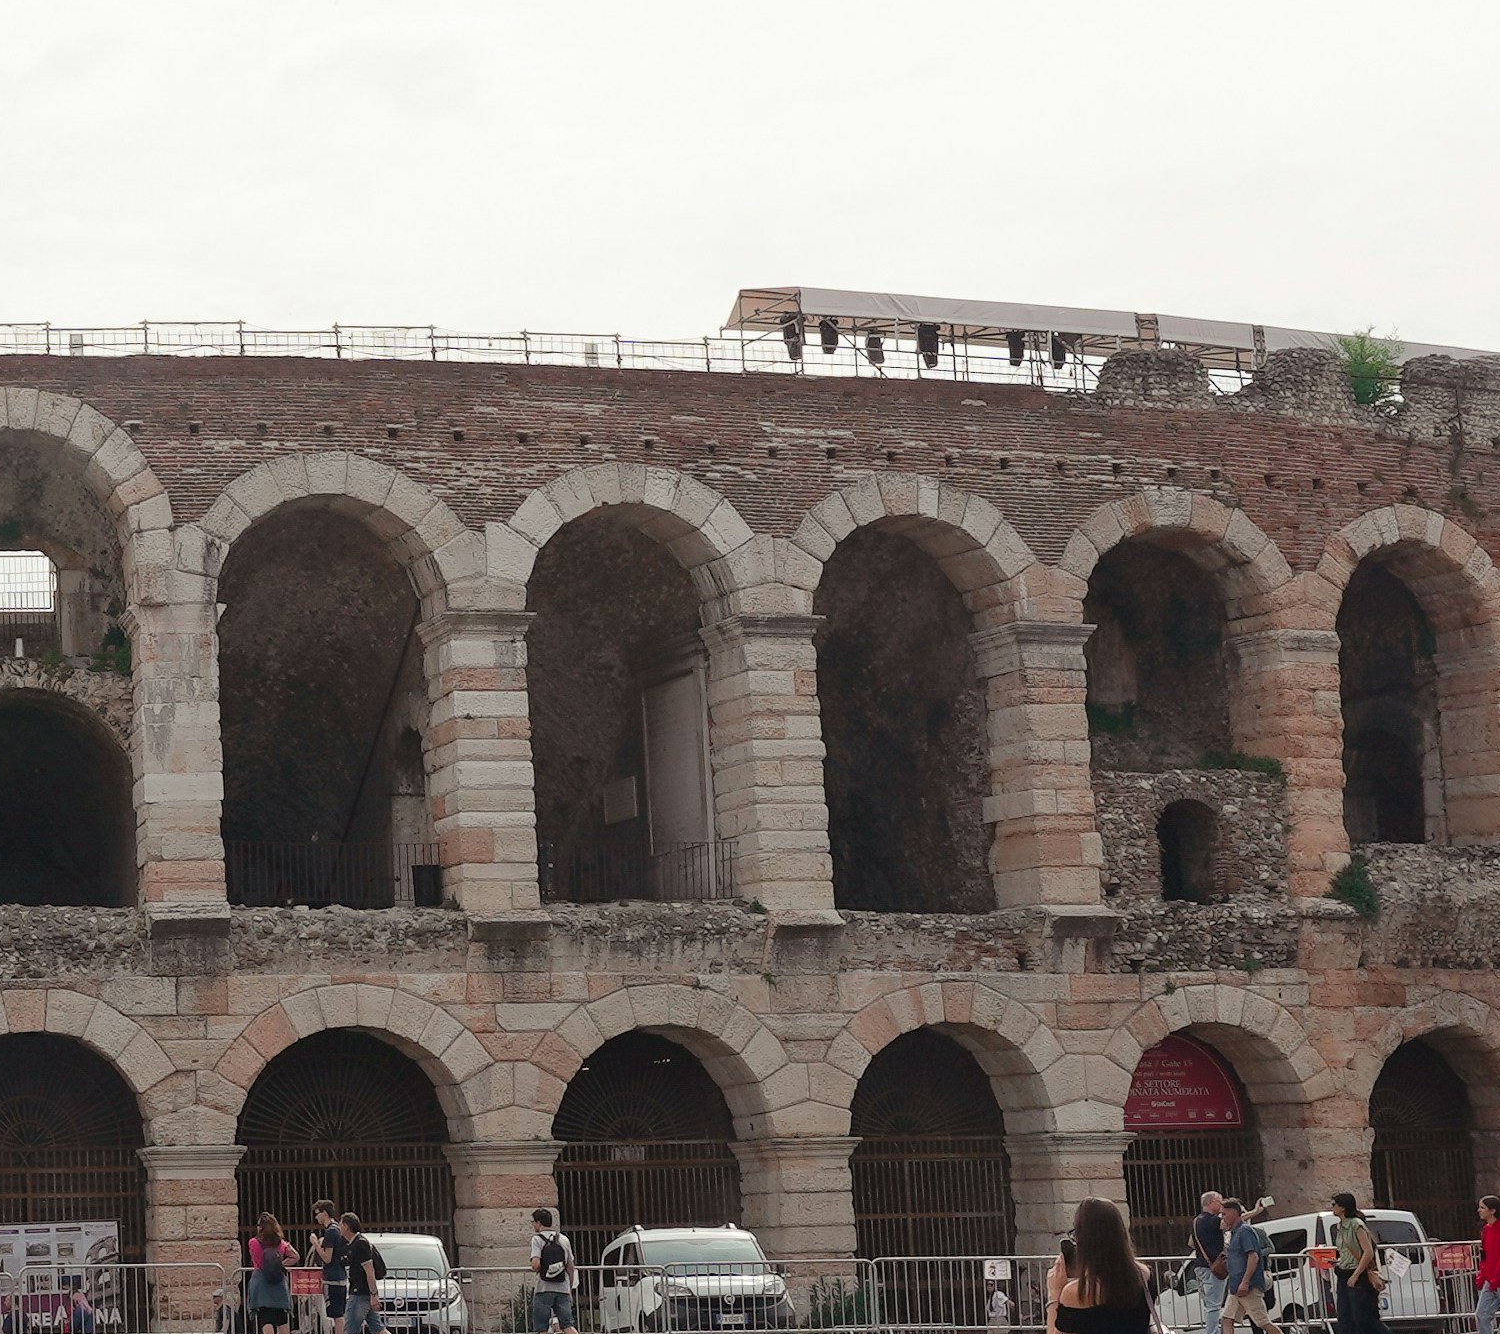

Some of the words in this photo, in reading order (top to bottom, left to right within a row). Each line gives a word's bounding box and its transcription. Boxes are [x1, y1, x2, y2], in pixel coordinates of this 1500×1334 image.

[1161, 1059, 1181, 1067] Gate
[1144, 1079, 1181, 1088] SETTORE
[1161, 1087, 1210, 1096] NUMERATA
